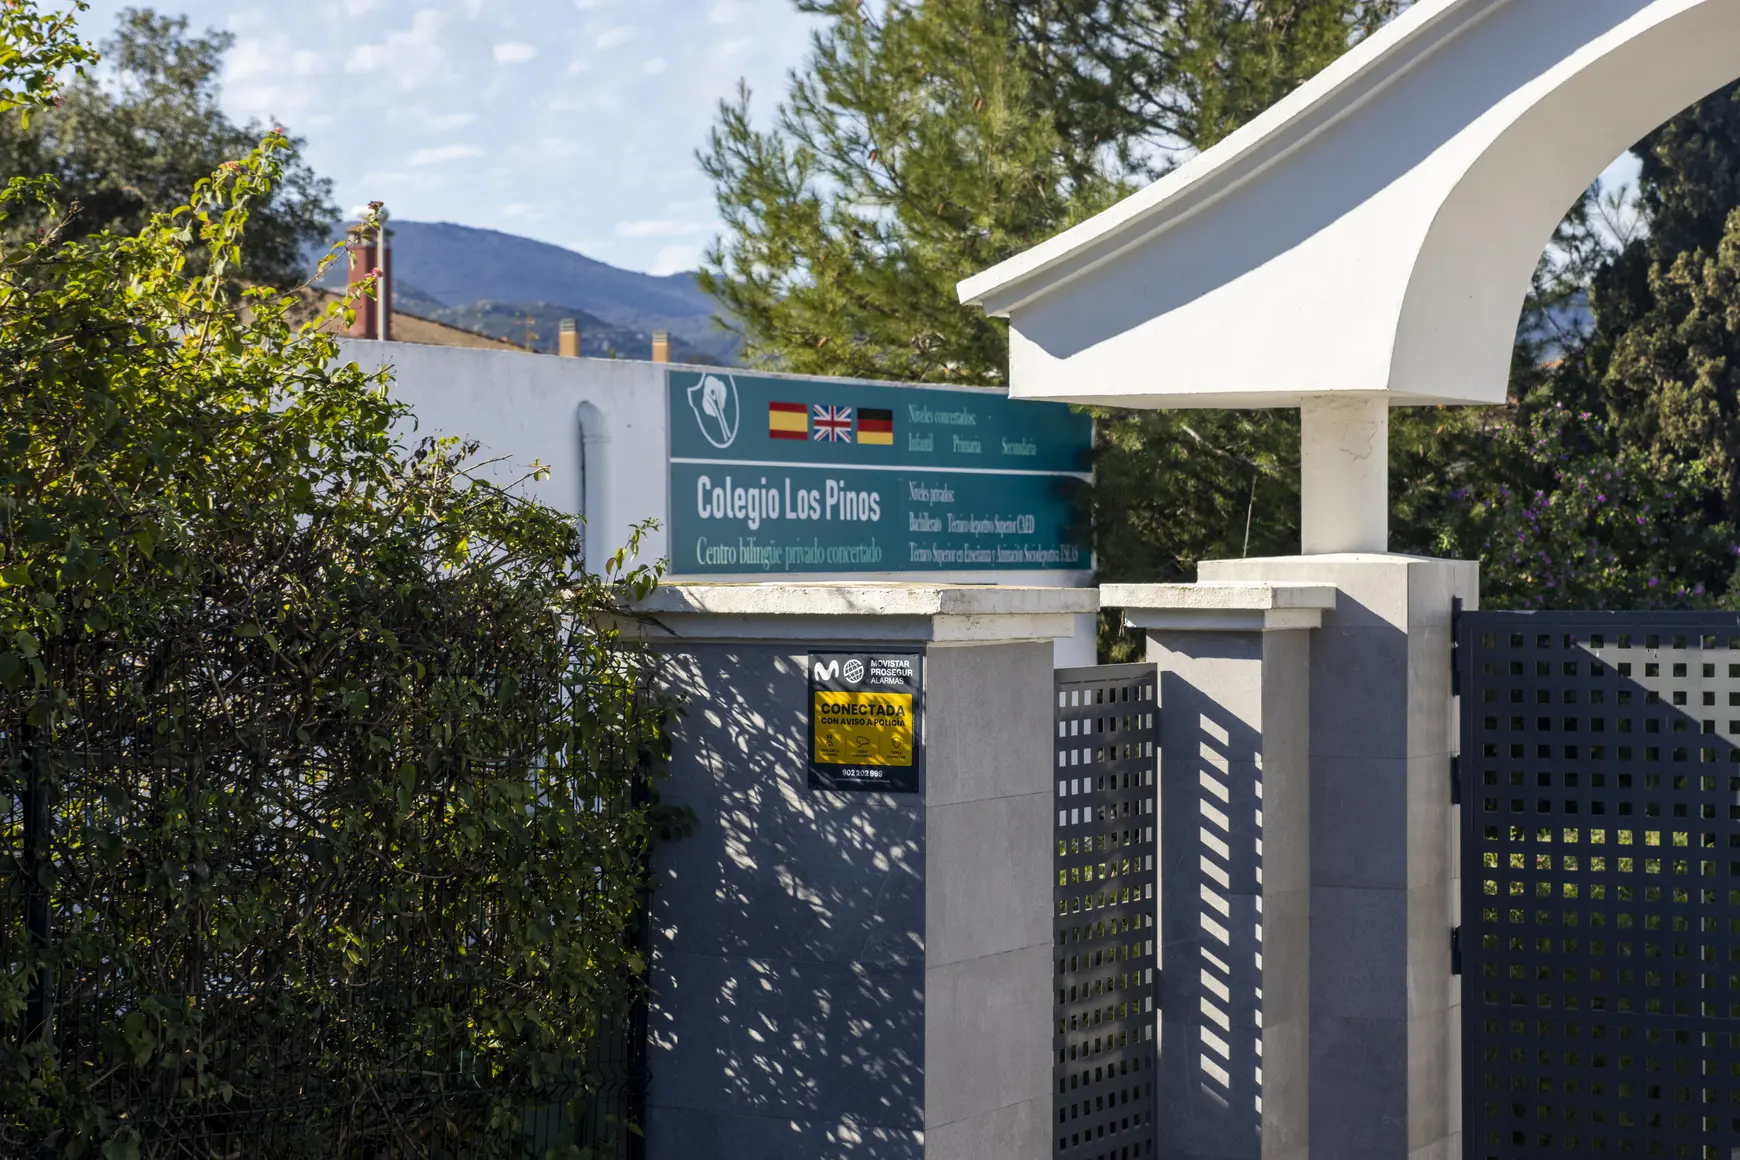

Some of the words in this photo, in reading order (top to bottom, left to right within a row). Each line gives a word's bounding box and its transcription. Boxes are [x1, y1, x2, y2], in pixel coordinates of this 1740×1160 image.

[908, 432, 934, 452] Infantil
[952, 433, 982, 453] Primaria
[1001, 436, 1037, 456] Secundaria
[697, 475, 780, 530] Colegio
[785, 477, 821, 520] Los
[825, 479, 880, 521] Pinos
[696, 536, 737, 565] Centro
[739, 536, 782, 571] bilingüe
[785, 536, 825, 571] privado
[827, 537, 882, 564] concertado
[870, 659, 910, 668] MOVISTAR
[870, 668, 914, 677] PROSEGUR
[870, 677, 905, 685] ALARMAS
[821, 702, 906, 717] CONECTADA
[821, 717, 839, 725] CON
[840, 717, 866, 726] AVISO
[866, 718, 873, 726] A
[873, 718, 906, 728] POLICÍA
[842, 768, 855, 777] 902
